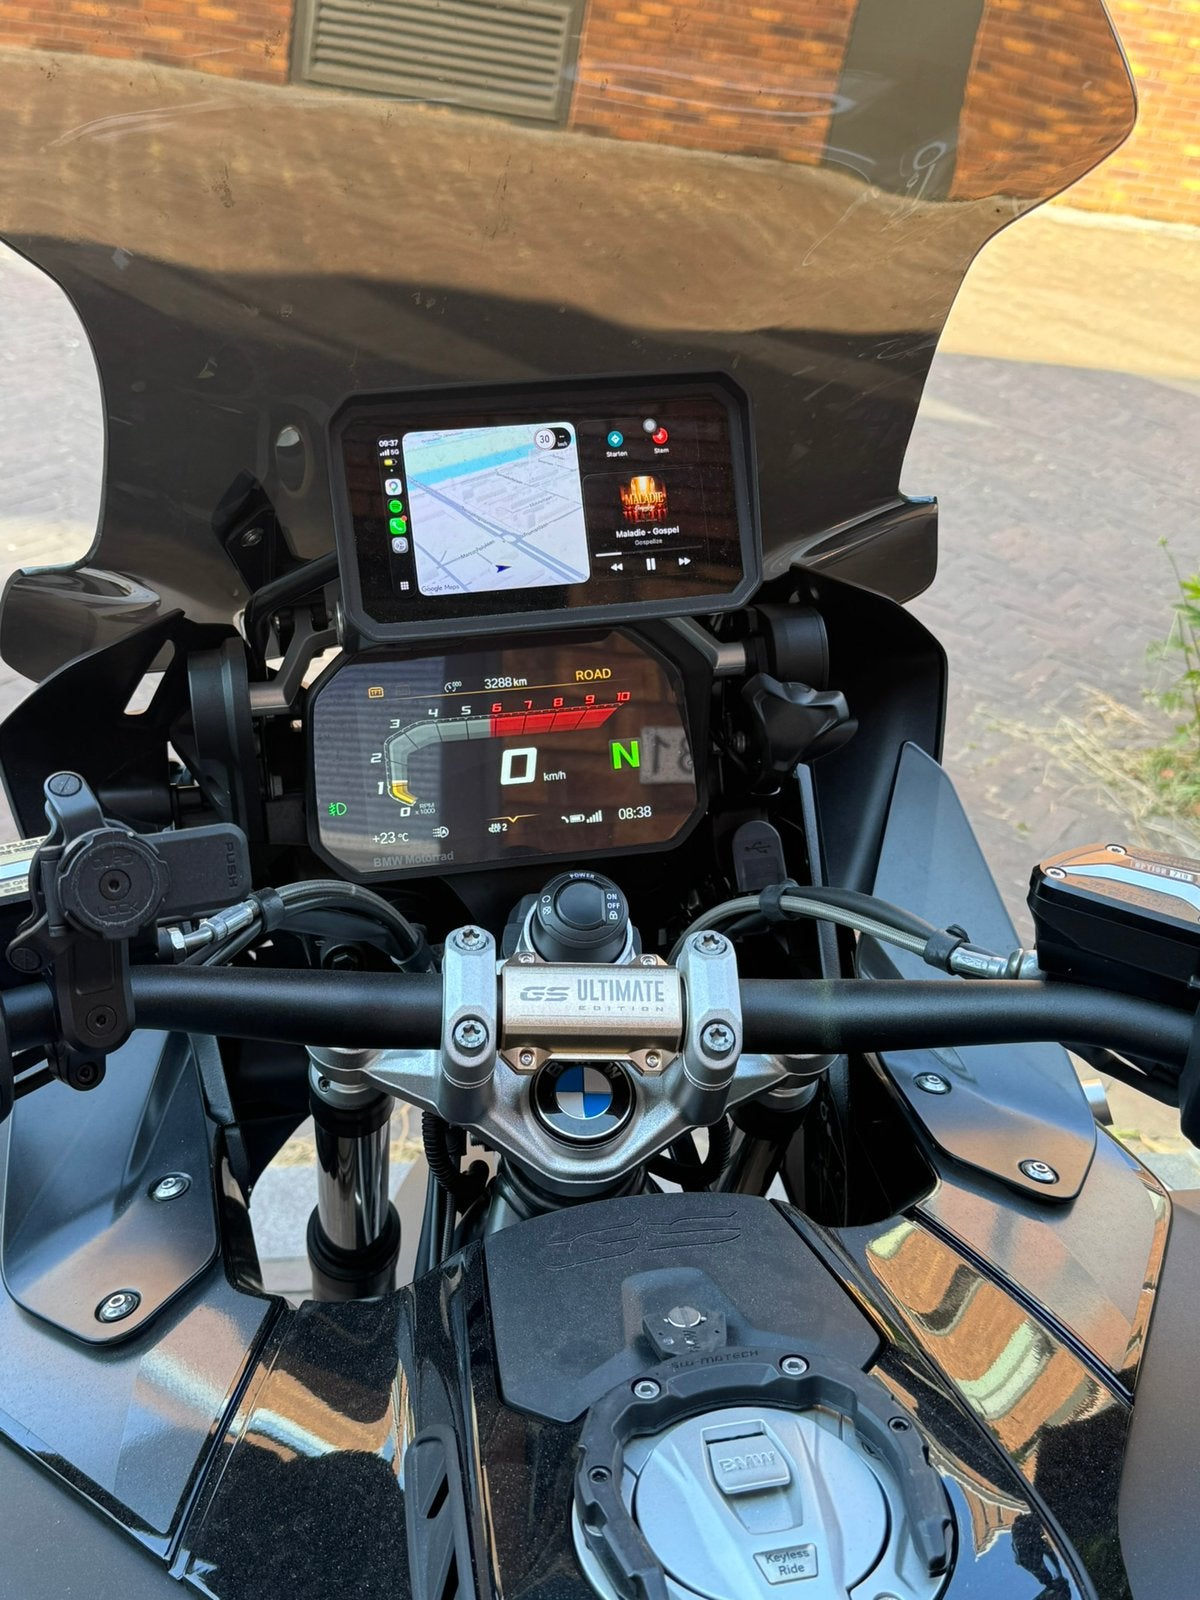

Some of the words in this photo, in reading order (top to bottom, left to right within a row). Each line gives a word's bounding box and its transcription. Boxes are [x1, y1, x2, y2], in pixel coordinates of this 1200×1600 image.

[378, 439, 399, 447] 09:37
[540, 435, 550, 443] 30
[624, 492, 664, 505] MALADIE
[616, 528, 646, 538] Maladie
[652, 526, 679, 535] Gospel
[444, 584, 460, 592] Maps
[575, 668, 612, 681] ROAD
[484, 677, 513, 689] 3288
[513, 678, 528, 687] km
[553, 698, 564, 707] 8
[585, 695, 595, 705] 9
[616, 691, 631, 702] 10
[460, 705, 472, 715] 5
[491, 703, 502, 713] 6
[524, 700, 533, 709] 7
[428, 708, 439, 717] 4
[389, 719, 400, 729] 3
[370, 753, 383, 763] 2
[612, 740, 640, 770] N
[500, 747, 538, 785] 0
[543, 771, 567, 781] km/h
[377, 781, 384, 795] 1
[400, 807, 411, 817] 0
[617, 805, 652, 820] 08:38
[502, 823, 508, 831] 2
[372, 832, 396, 844] +23
[225, 841, 238, 890] PUSH
[373, 856, 401, 868] BMW
[405, 851, 454, 866] Motorrad
[98, 902, 138, 918] LOCK
[520, 986, 570, 1001] GS
[577, 979, 664, 1001] ULTIMATE
[718, 1450, 775, 1473] BMW
[766, 1549, 811, 1564] Keyless
[779, 1562, 805, 1576] Ride
